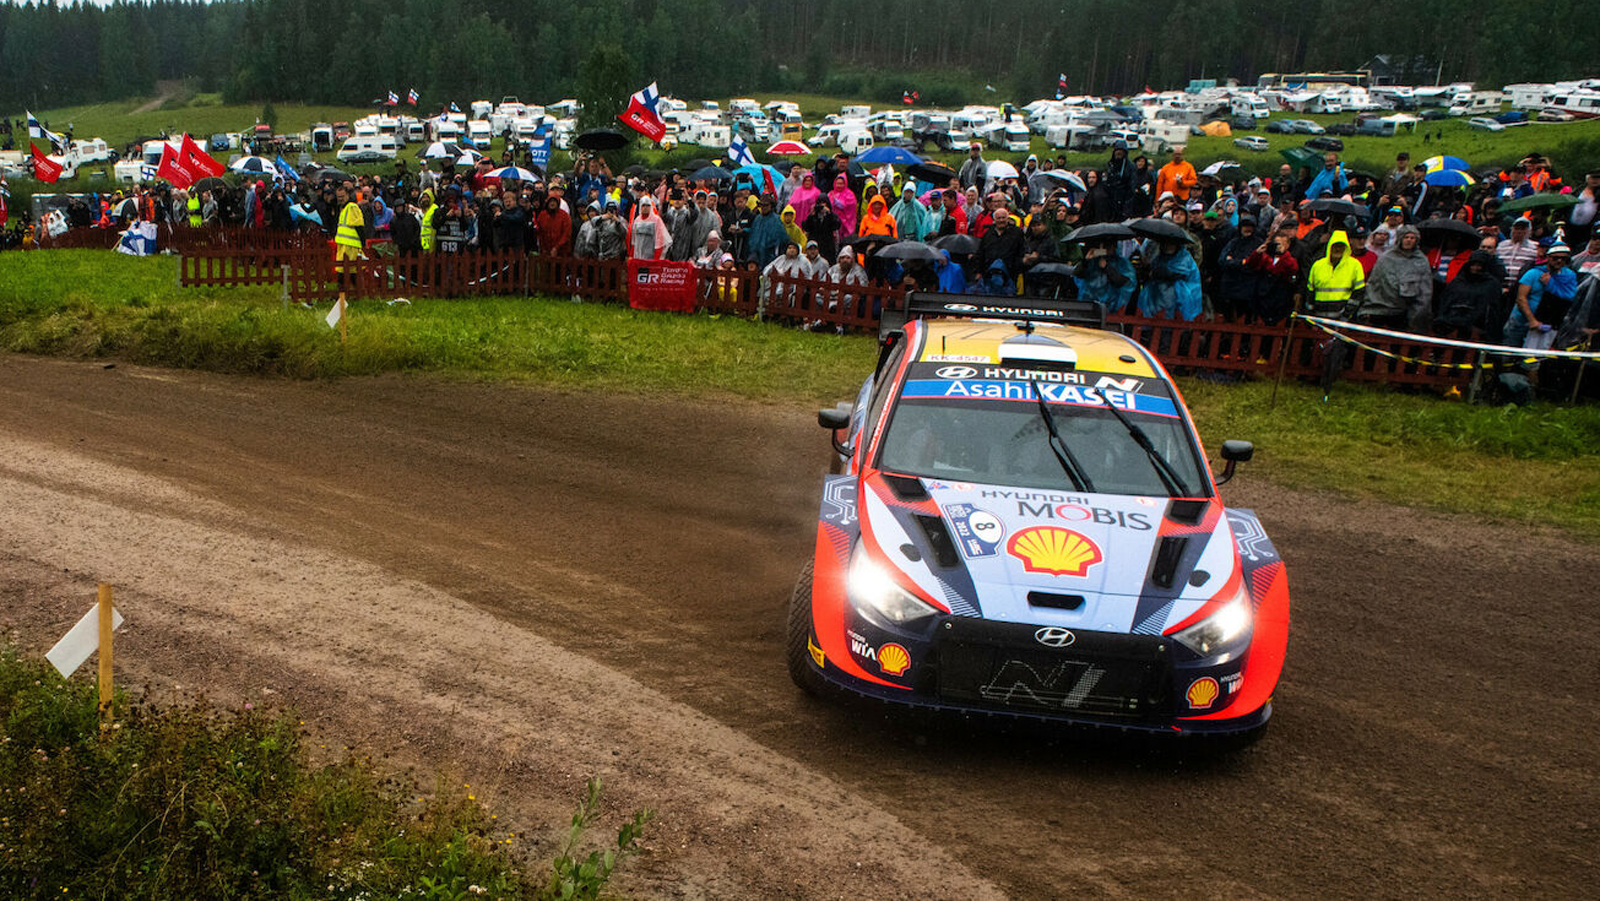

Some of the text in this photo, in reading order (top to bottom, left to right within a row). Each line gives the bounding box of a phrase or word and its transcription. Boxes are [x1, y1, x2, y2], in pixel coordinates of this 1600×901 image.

[441, 241, 458, 252] 613
[637, 273, 659, 283] GR
[982, 306, 1064, 317] HYUNDAI
[930, 354, 987, 363] KK-4547
[984, 368, 1085, 384] HYUNDAI
[982, 491, 1089, 505] HYUNDAI
[1017, 501, 1154, 532] MOBIS
[975, 522, 995, 531] 8
